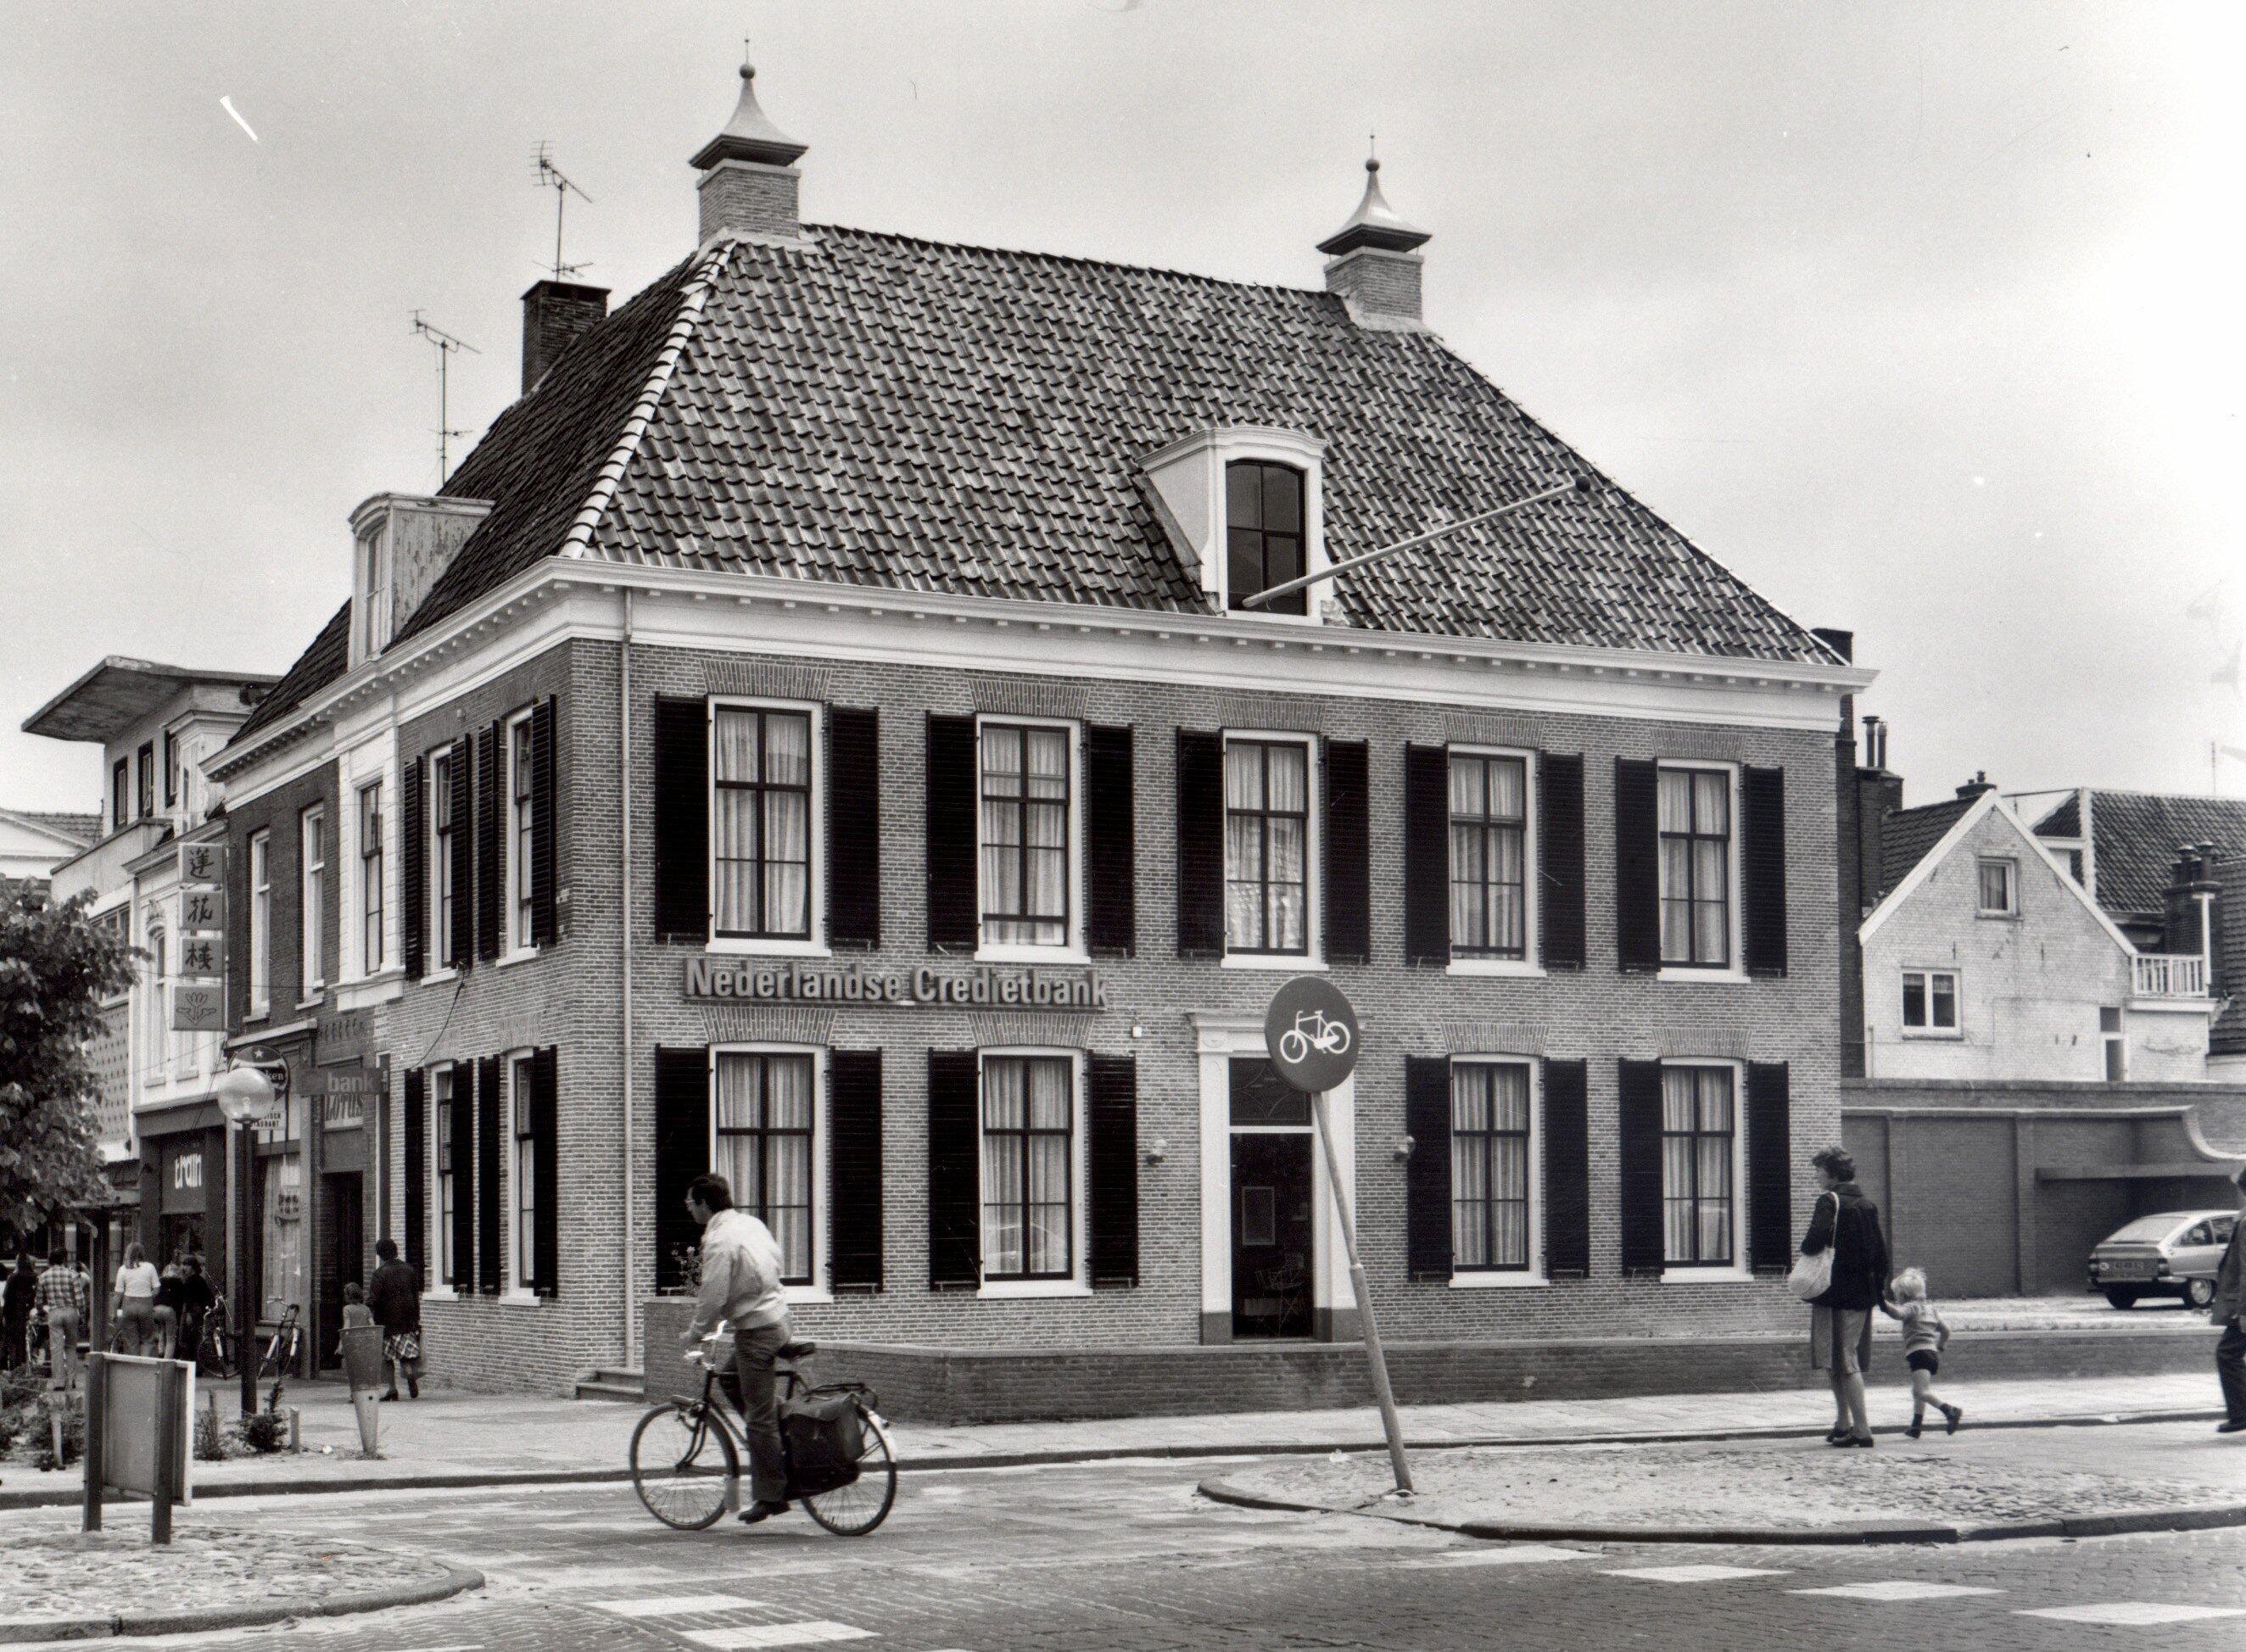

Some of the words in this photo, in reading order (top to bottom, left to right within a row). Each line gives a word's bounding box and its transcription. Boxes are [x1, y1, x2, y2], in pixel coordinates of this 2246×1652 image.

[684, 957, 902, 1001] Nederlandse
[913, 966, 1109, 1007] Credietbank
[327, 1071, 379, 1092] bank
[175, 1153, 202, 1189] train
